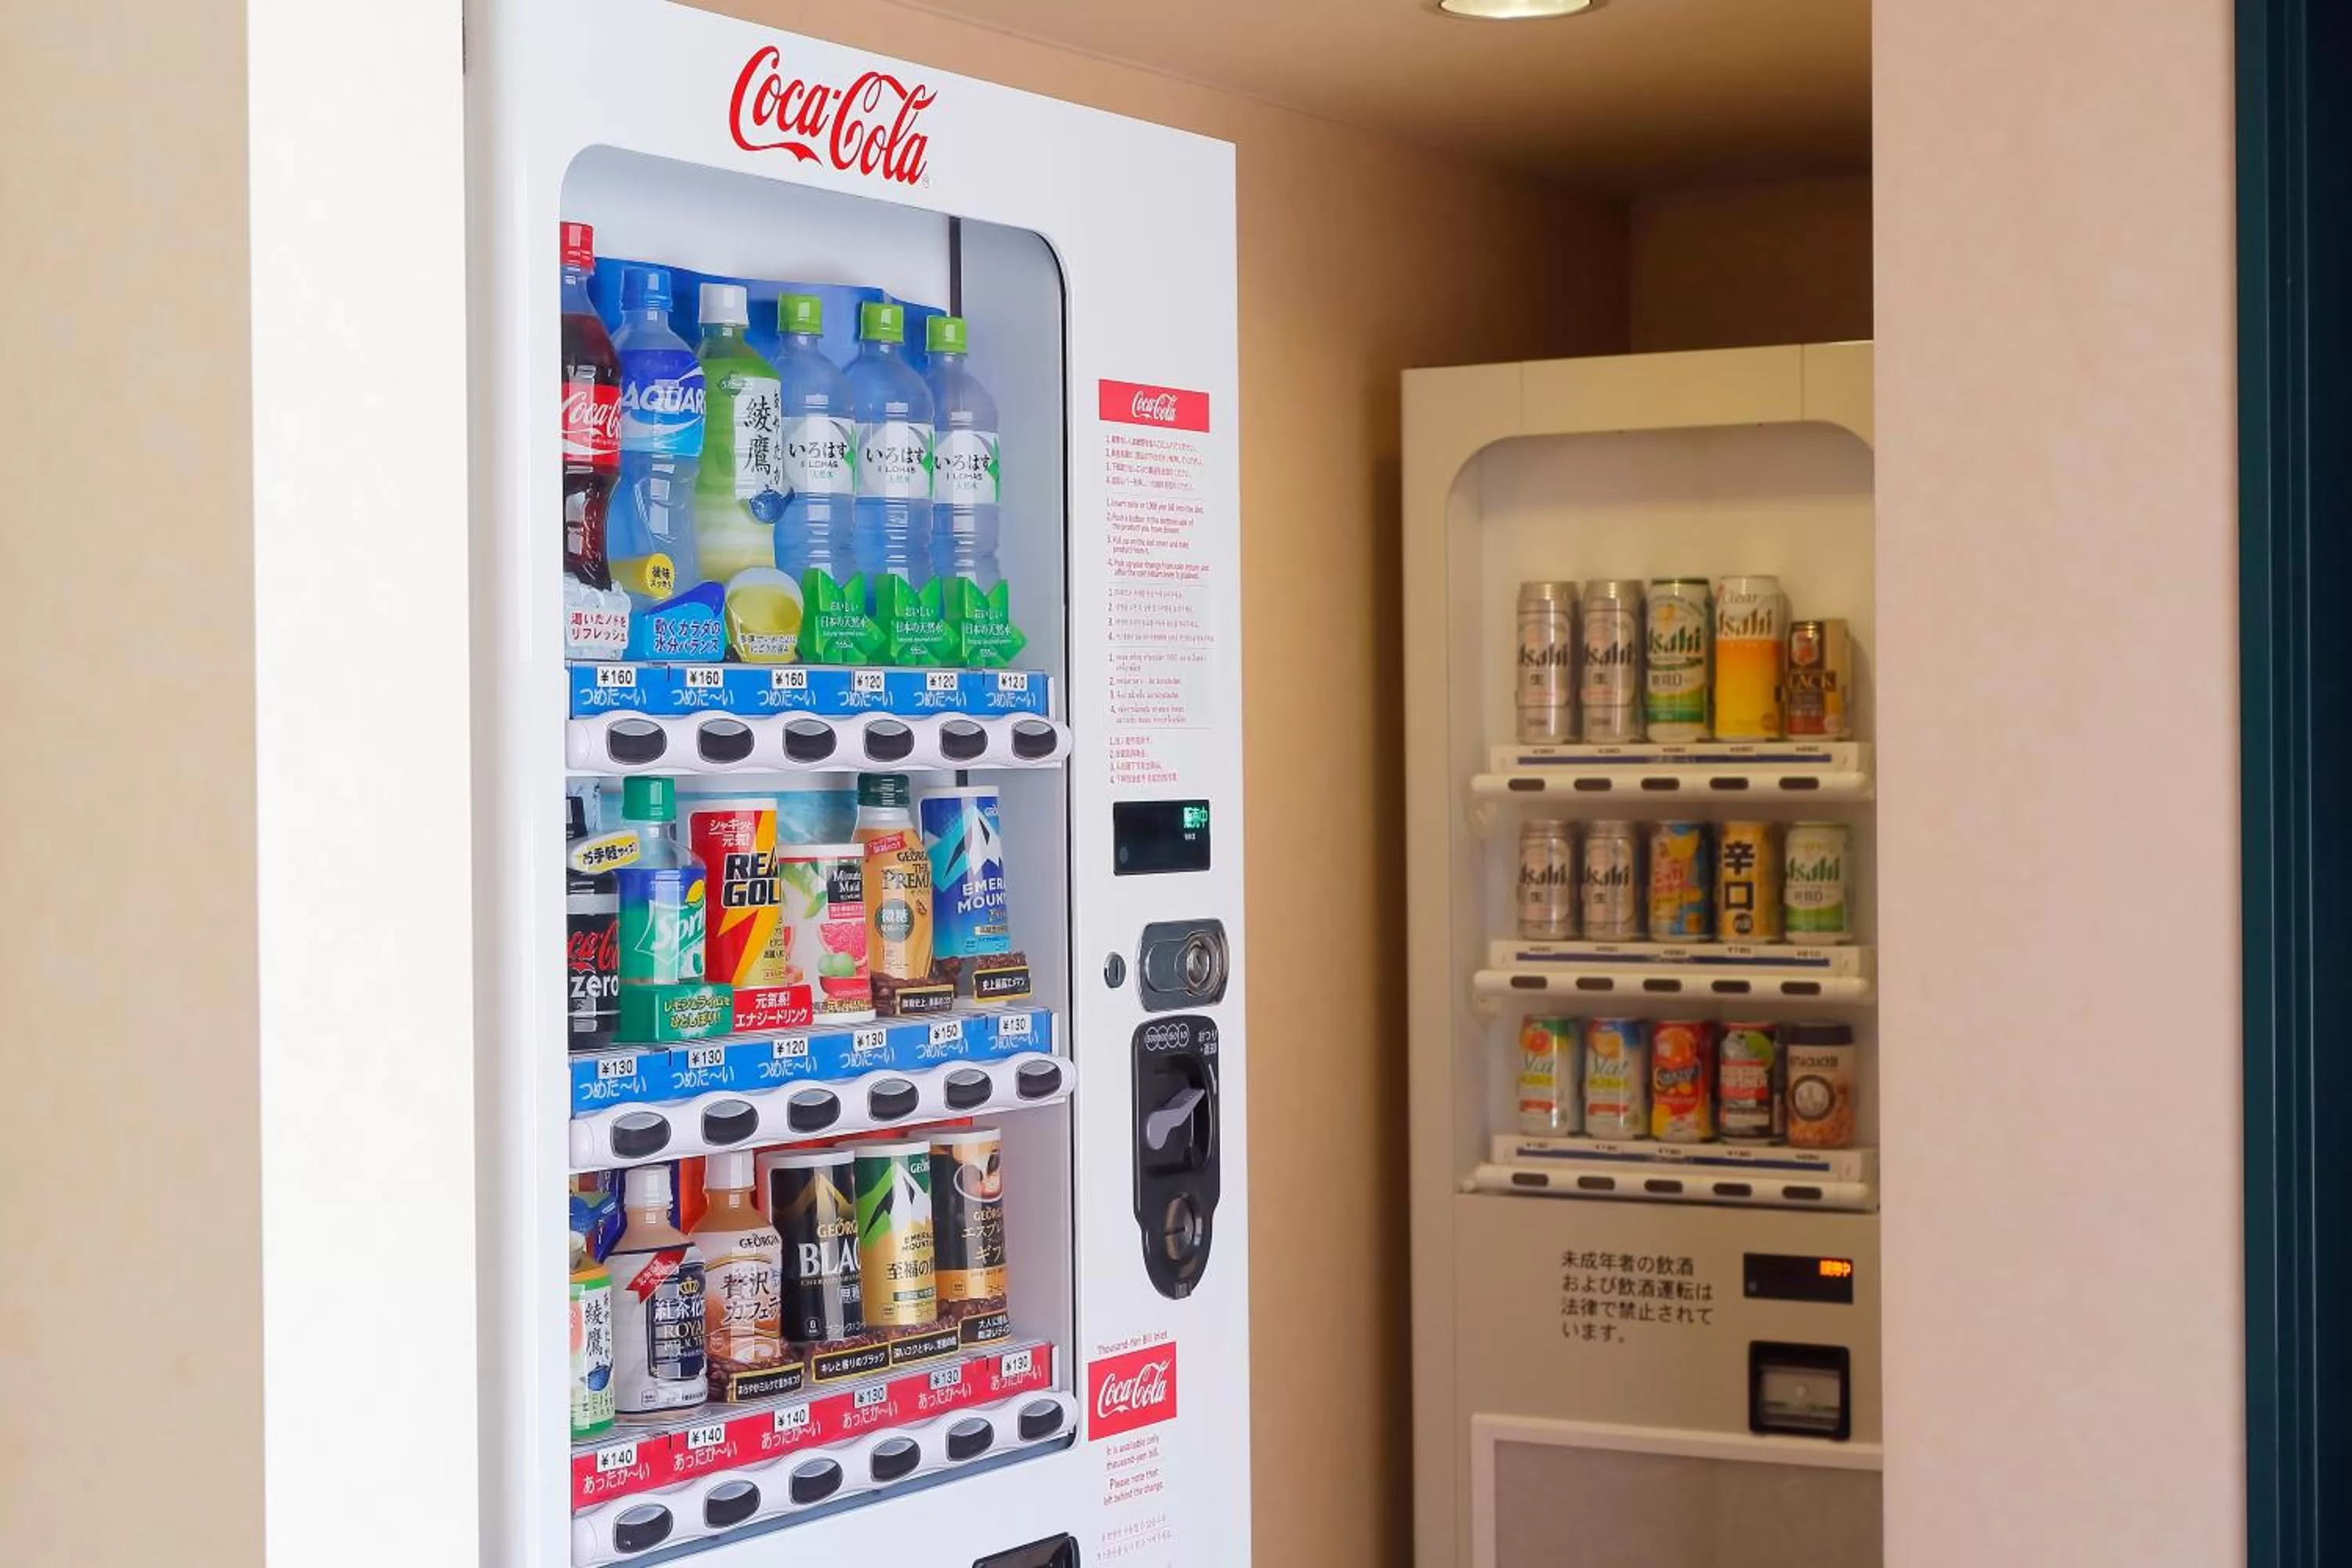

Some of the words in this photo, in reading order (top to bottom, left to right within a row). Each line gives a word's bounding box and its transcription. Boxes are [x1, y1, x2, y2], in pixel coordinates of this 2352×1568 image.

[728, 45, 938, 185] Coca-Cola
[1131, 390, 1178, 422] Coca-Cola
[744, 395, 772, 475] 綾鷹
[789, 442, 848, 458] いろはす
[866, 448, 924, 463] いろはす
[935, 455, 989, 470] いろはす
[572, 628, 626, 642] リフレッシュ
[654, 618, 720, 637] 動くカラダの
[654, 636, 719, 654] 水分バランス
[601, 670, 632, 684] ¥160
[690, 671, 719, 685] ¥160
[775, 673, 804, 686] ¥160
[857, 674, 882, 688] ¥120
[930, 675, 955, 688] ¥120
[1001, 676, 1025, 688] ¥120
[1725, 840, 1755, 912] 辛口
[570, 975, 619, 999] zero
[735, 1008, 808, 1029] エナジードリンク
[856, 1031, 884, 1047] ¥130
[933, 1025, 957, 1040] ¥150
[691, 1049, 722, 1065] ¥130
[777, 1040, 805, 1056] ¥120
[602, 1058, 633, 1075] ¥130
[886, 1259, 934, 1281] 至福の
[1561, 1250, 1694, 1276] 未成年者の飲酒
[1562, 1274, 1714, 1301] および飲酒運転は
[1561, 1298, 1715, 1325] 法律で禁止されて
[1562, 1323, 1625, 1344] います。
[933, 1369, 958, 1387] ¥130
[1097, 1359, 1172, 1418] Coca-Cola
[778, 1409, 806, 1427] ¥140
[691, 1428, 722, 1445] ¥140
[601, 1450, 633, 1468] ¥140
